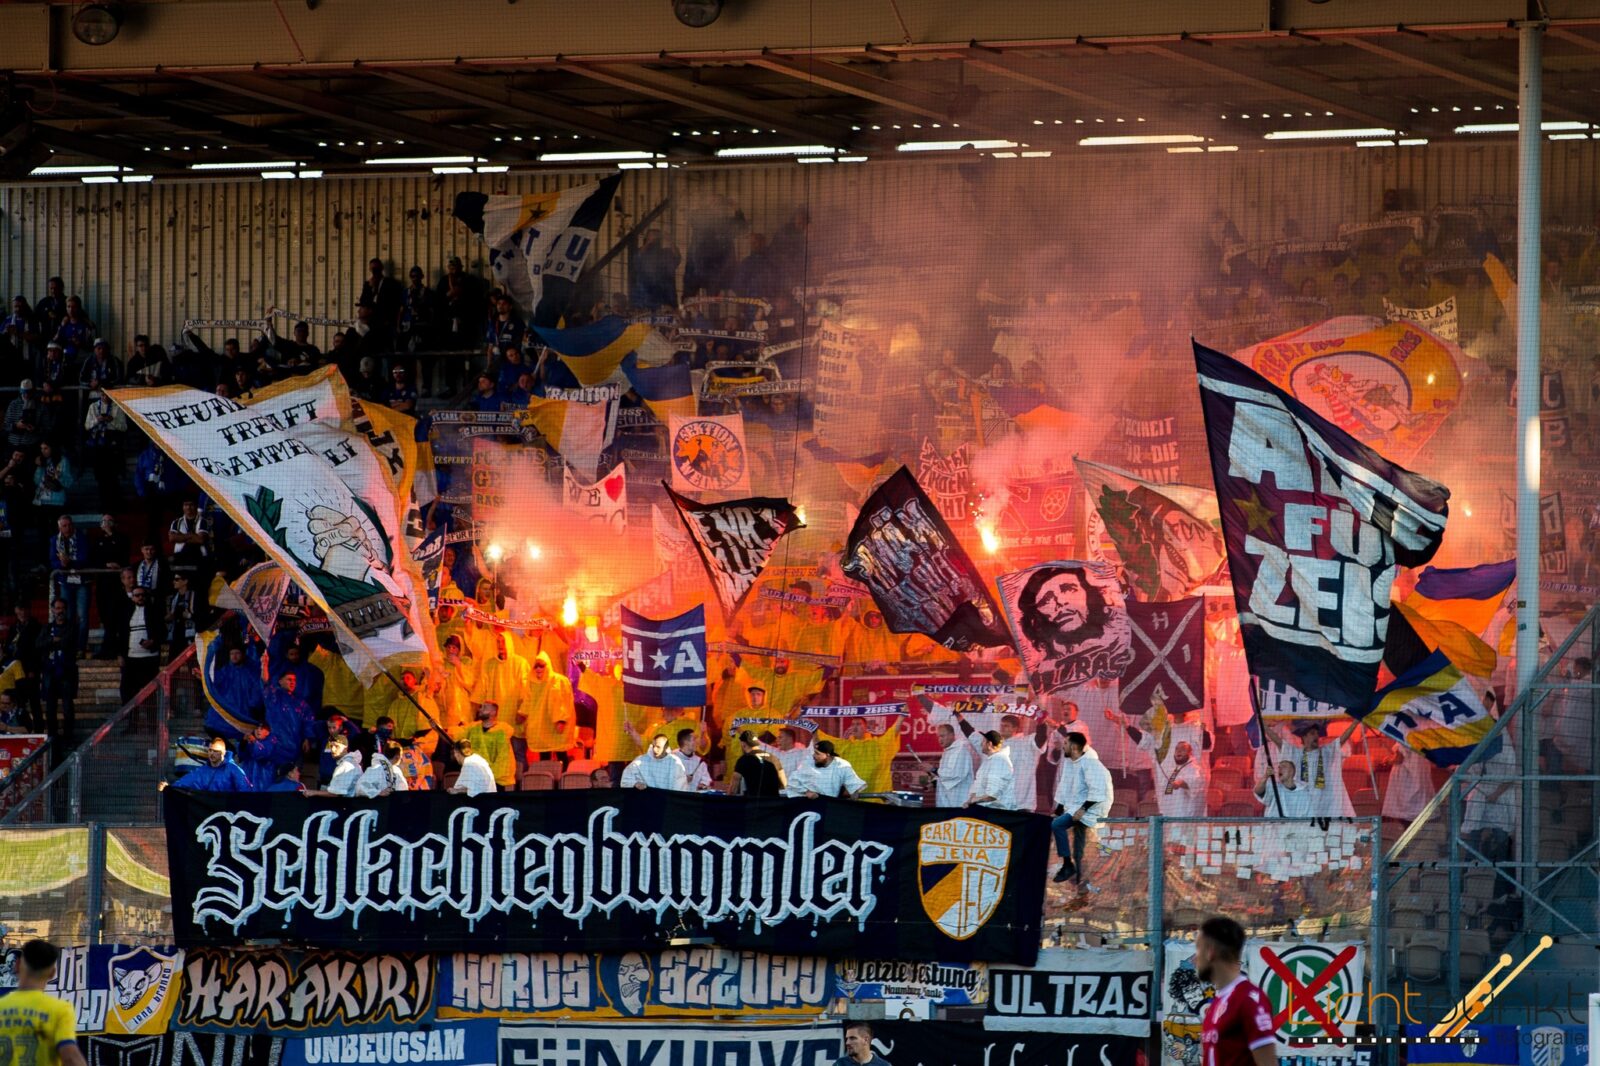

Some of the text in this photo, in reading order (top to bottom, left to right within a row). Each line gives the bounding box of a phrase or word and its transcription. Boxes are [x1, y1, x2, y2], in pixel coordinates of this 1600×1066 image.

[805, 707, 831, 717] ALLE
[864, 704, 897, 715] ZEISS
[925, 822, 1005, 845] CARL ZEISS
[192, 806, 894, 930] Schlachtenbummler
[935, 847, 990, 863] JENA
[185, 953, 432, 1029] HARAKIRI
[994, 973, 1150, 1016] ULTRAS
[304, 1028, 466, 1064] UNBEUGSAM
